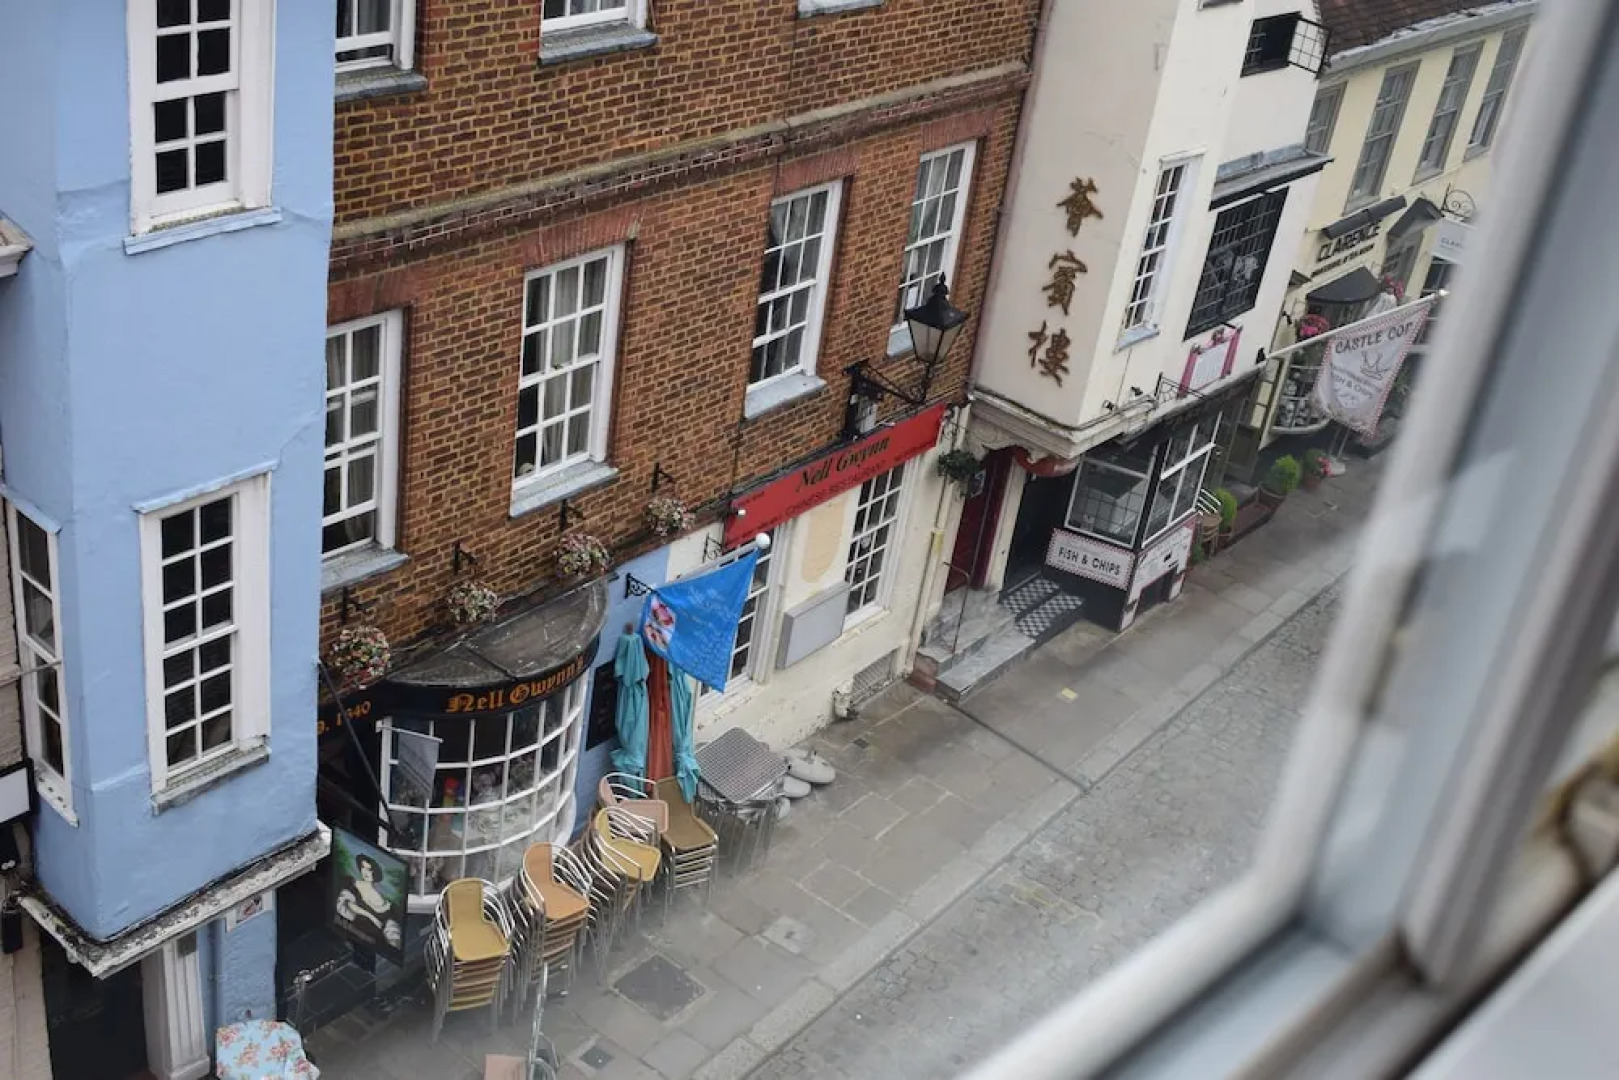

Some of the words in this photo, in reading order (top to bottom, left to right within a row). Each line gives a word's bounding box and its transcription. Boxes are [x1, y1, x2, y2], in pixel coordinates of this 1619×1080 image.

[1316, 222, 1381, 262] CLARENCE
[1335, 330, 1383, 353] CASTLE
[795, 457, 834, 492] Nell
[836, 436, 890, 472] Gwynn
[1058, 546, 1079, 562] FISH
[1082, 554, 1089, 565] &
[1092, 558, 1121, 575] CHIPS
[445, 689, 504, 714] Nell
